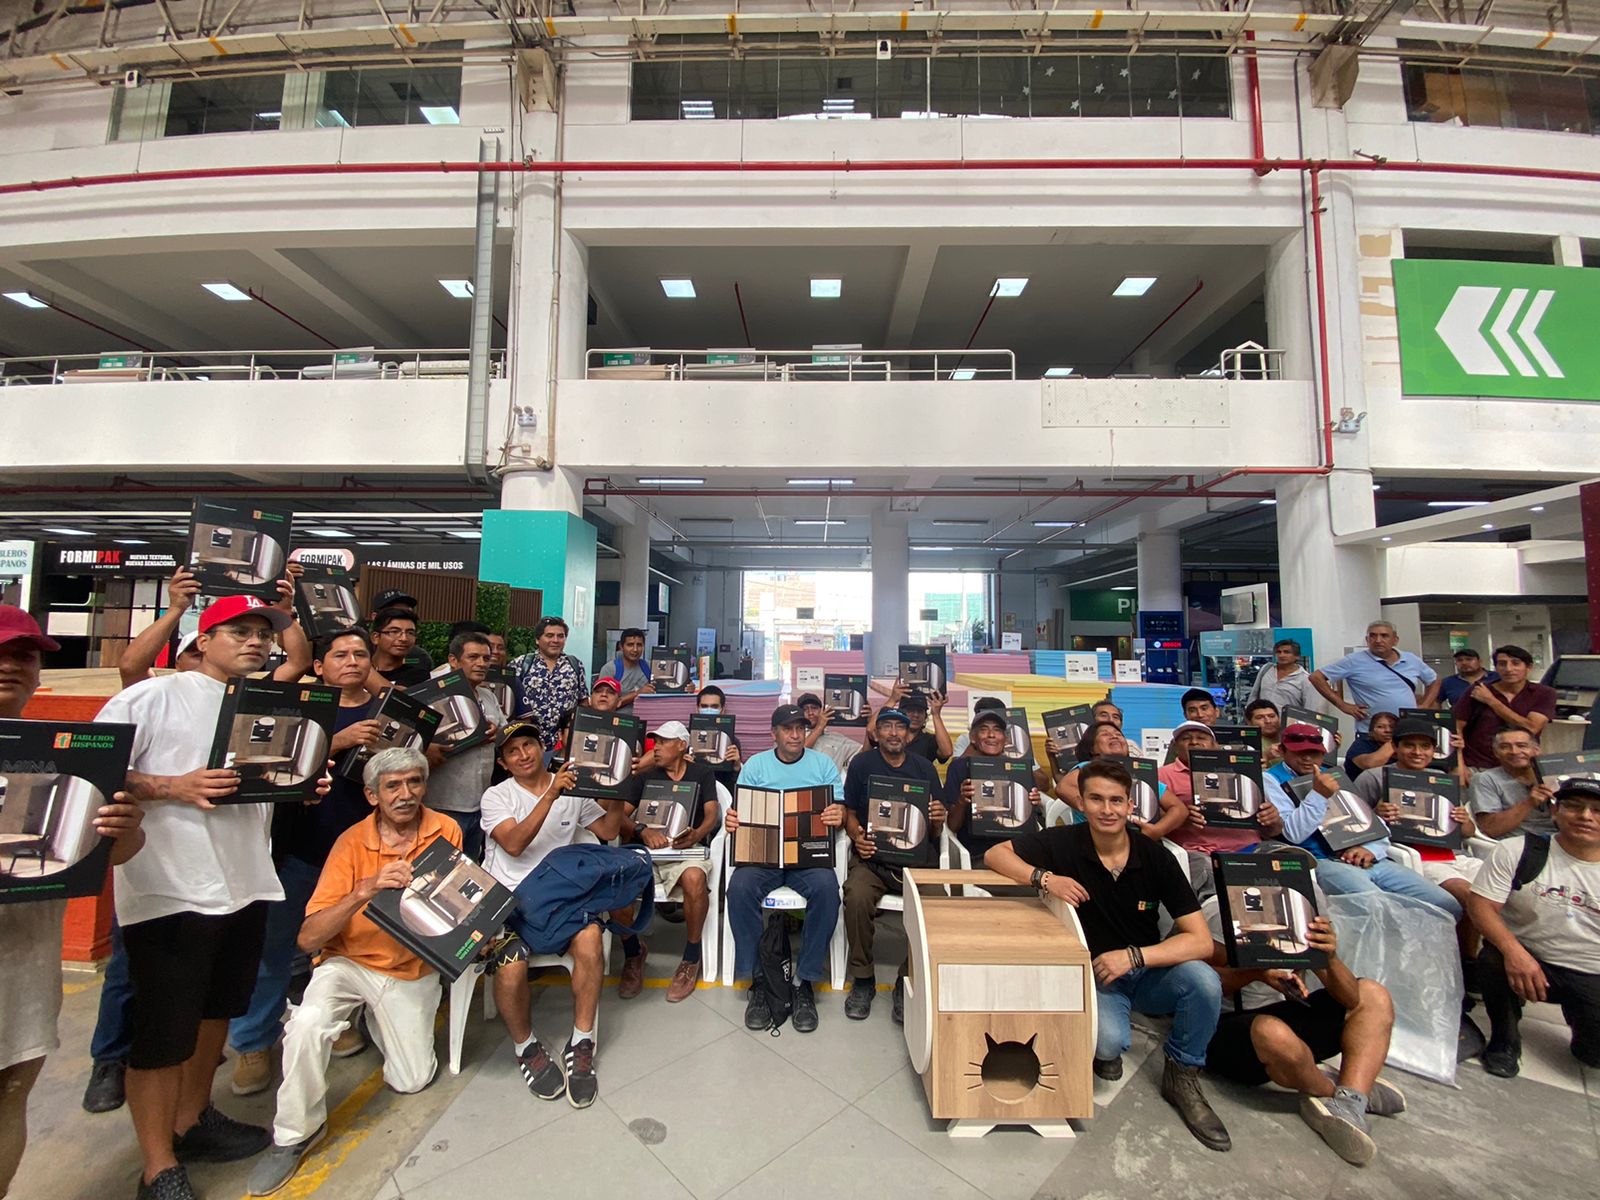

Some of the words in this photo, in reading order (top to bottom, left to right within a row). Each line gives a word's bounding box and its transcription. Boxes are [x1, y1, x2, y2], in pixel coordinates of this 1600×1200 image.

[60, 550, 120, 564] FORMIPAK
[300, 553, 343, 566] FORMIPAK
[416, 561, 427, 570] DE
[428, 561, 442, 570] MIL
[443, 561, 464, 570] USOS
[1118, 598, 1136, 614] PI
[70, 741, 114, 749] HISPANOS
